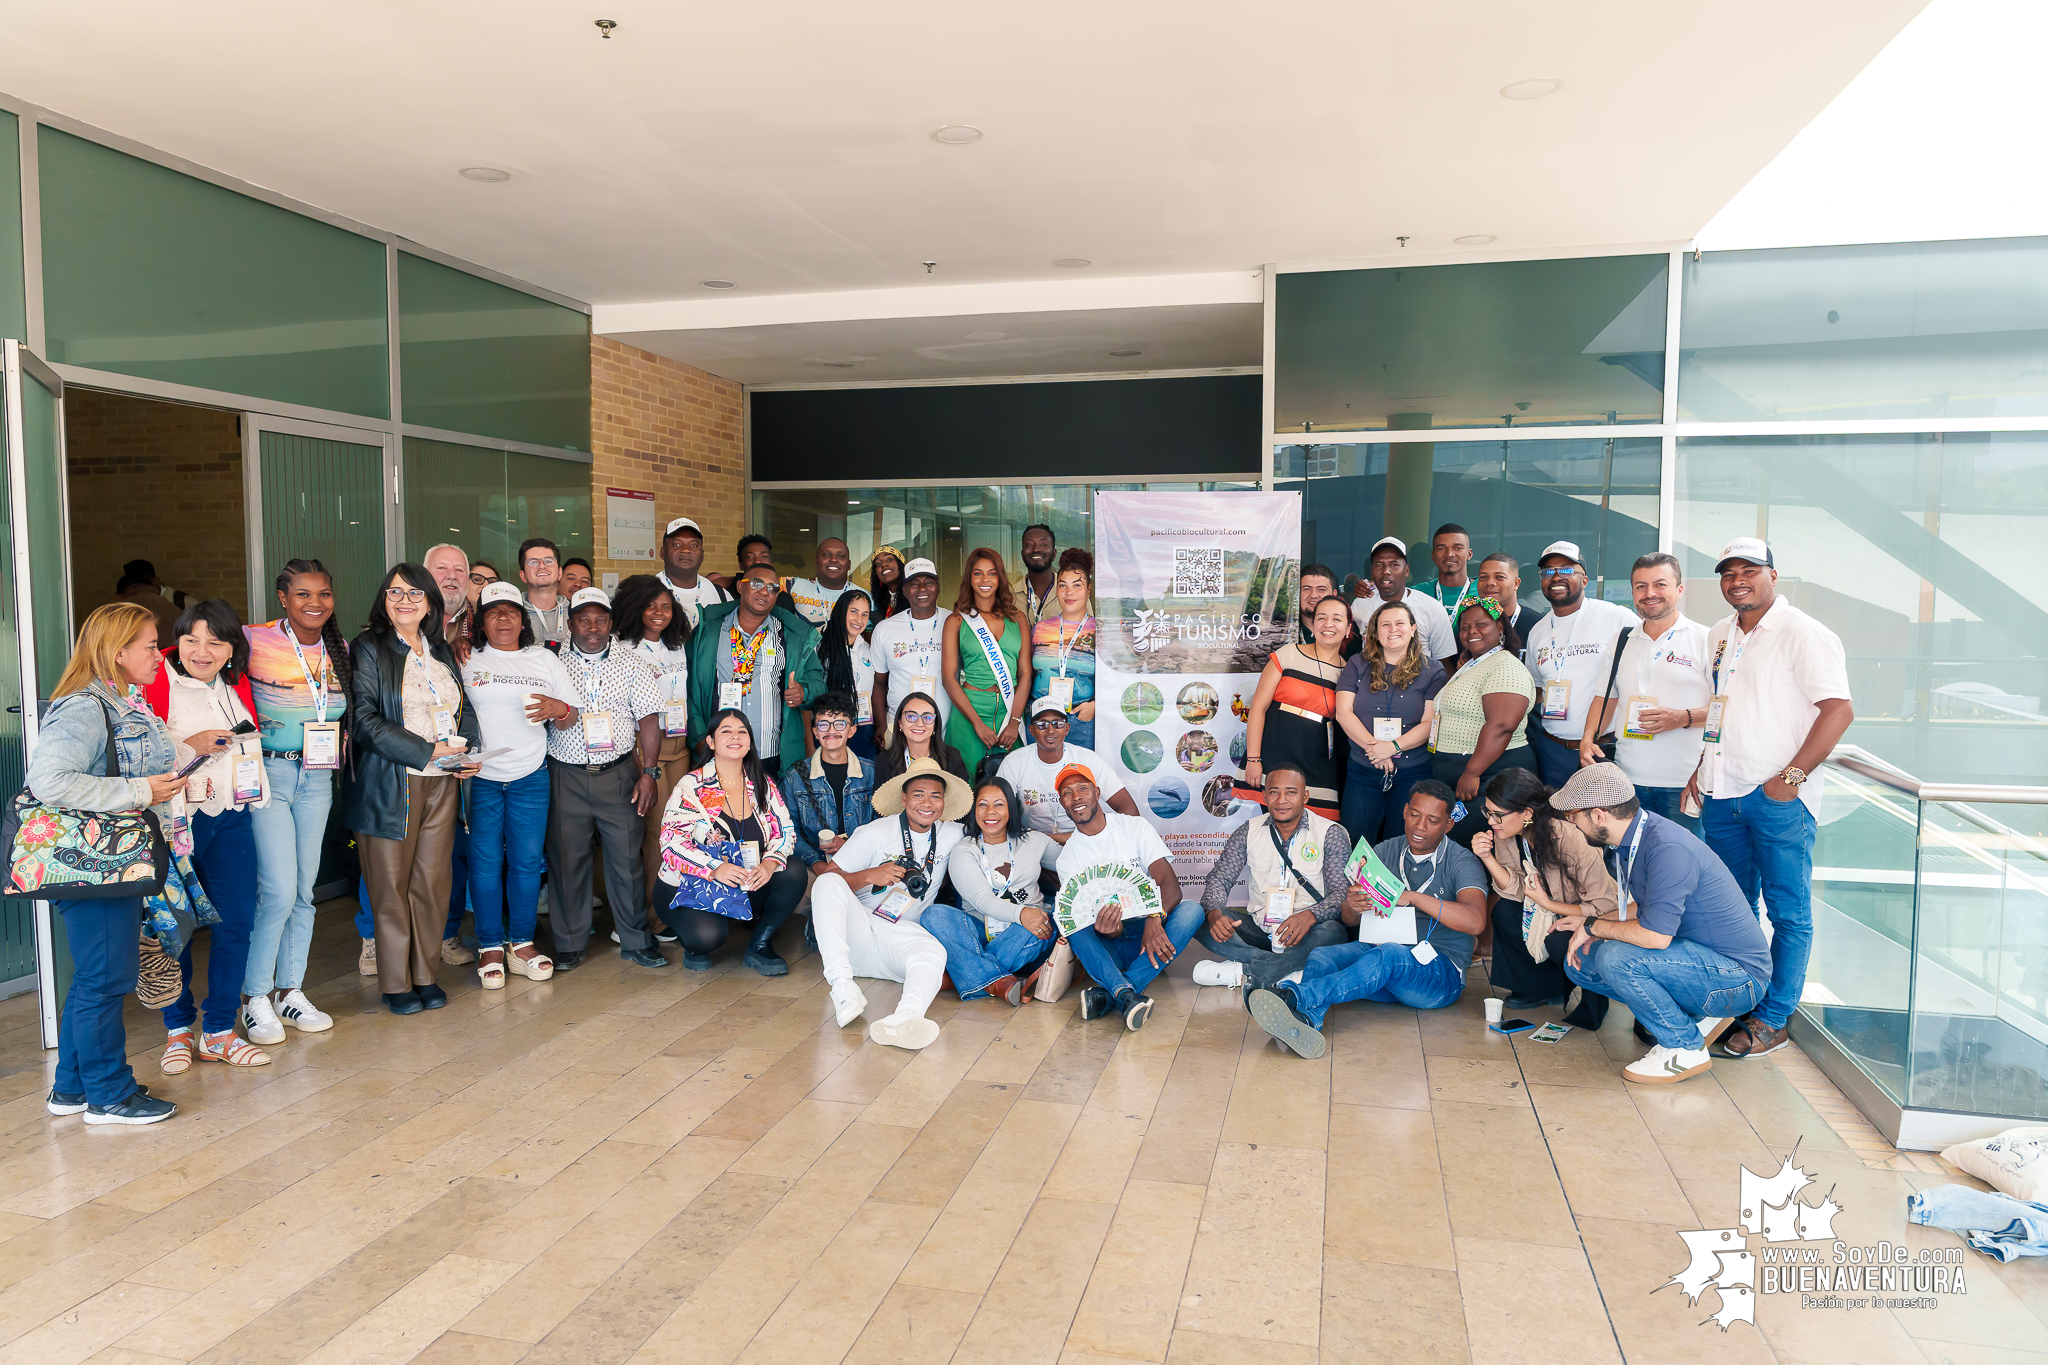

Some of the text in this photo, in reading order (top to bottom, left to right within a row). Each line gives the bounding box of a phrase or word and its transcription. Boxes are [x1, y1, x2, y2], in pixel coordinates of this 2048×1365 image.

[1174, 611, 1262, 624] PACÍFICO
[1175, 624, 1261, 641] TURISMO
[977, 627, 1012, 699] BUENAVENTURA
[492, 678, 547, 688] BIOCULTURAL
[903, 829, 911, 848] SONY
[1164, 833, 1188, 841] playas
[1193, 856, 1212, 864] hable
[1985, 1143, 2002, 1153] BIA
